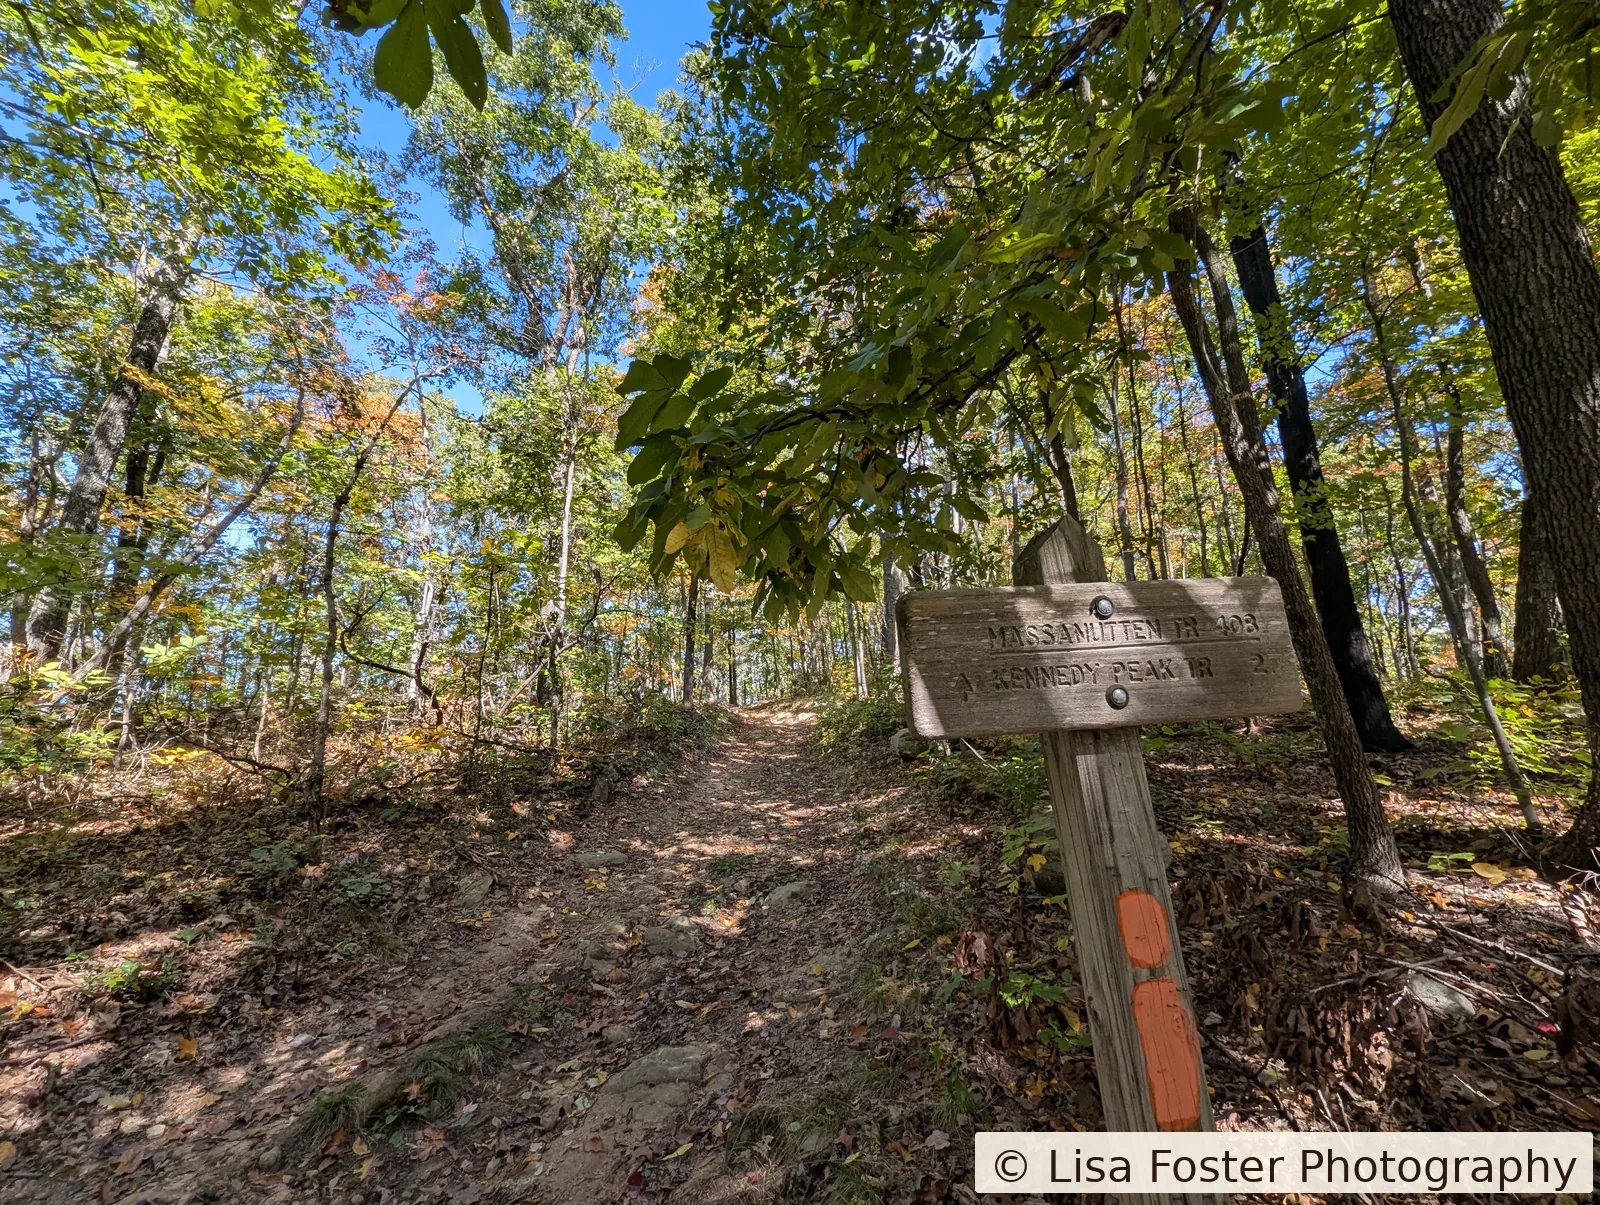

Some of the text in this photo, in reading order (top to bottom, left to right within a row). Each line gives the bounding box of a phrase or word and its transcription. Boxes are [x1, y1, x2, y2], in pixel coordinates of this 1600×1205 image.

[988, 613, 1260, 648] MASSANUTTEN TR 408
[992, 662, 1100, 690] KENNEDY
[1112, 657, 1177, 684] PEAK
[1183, 656, 1214, 679] TR
